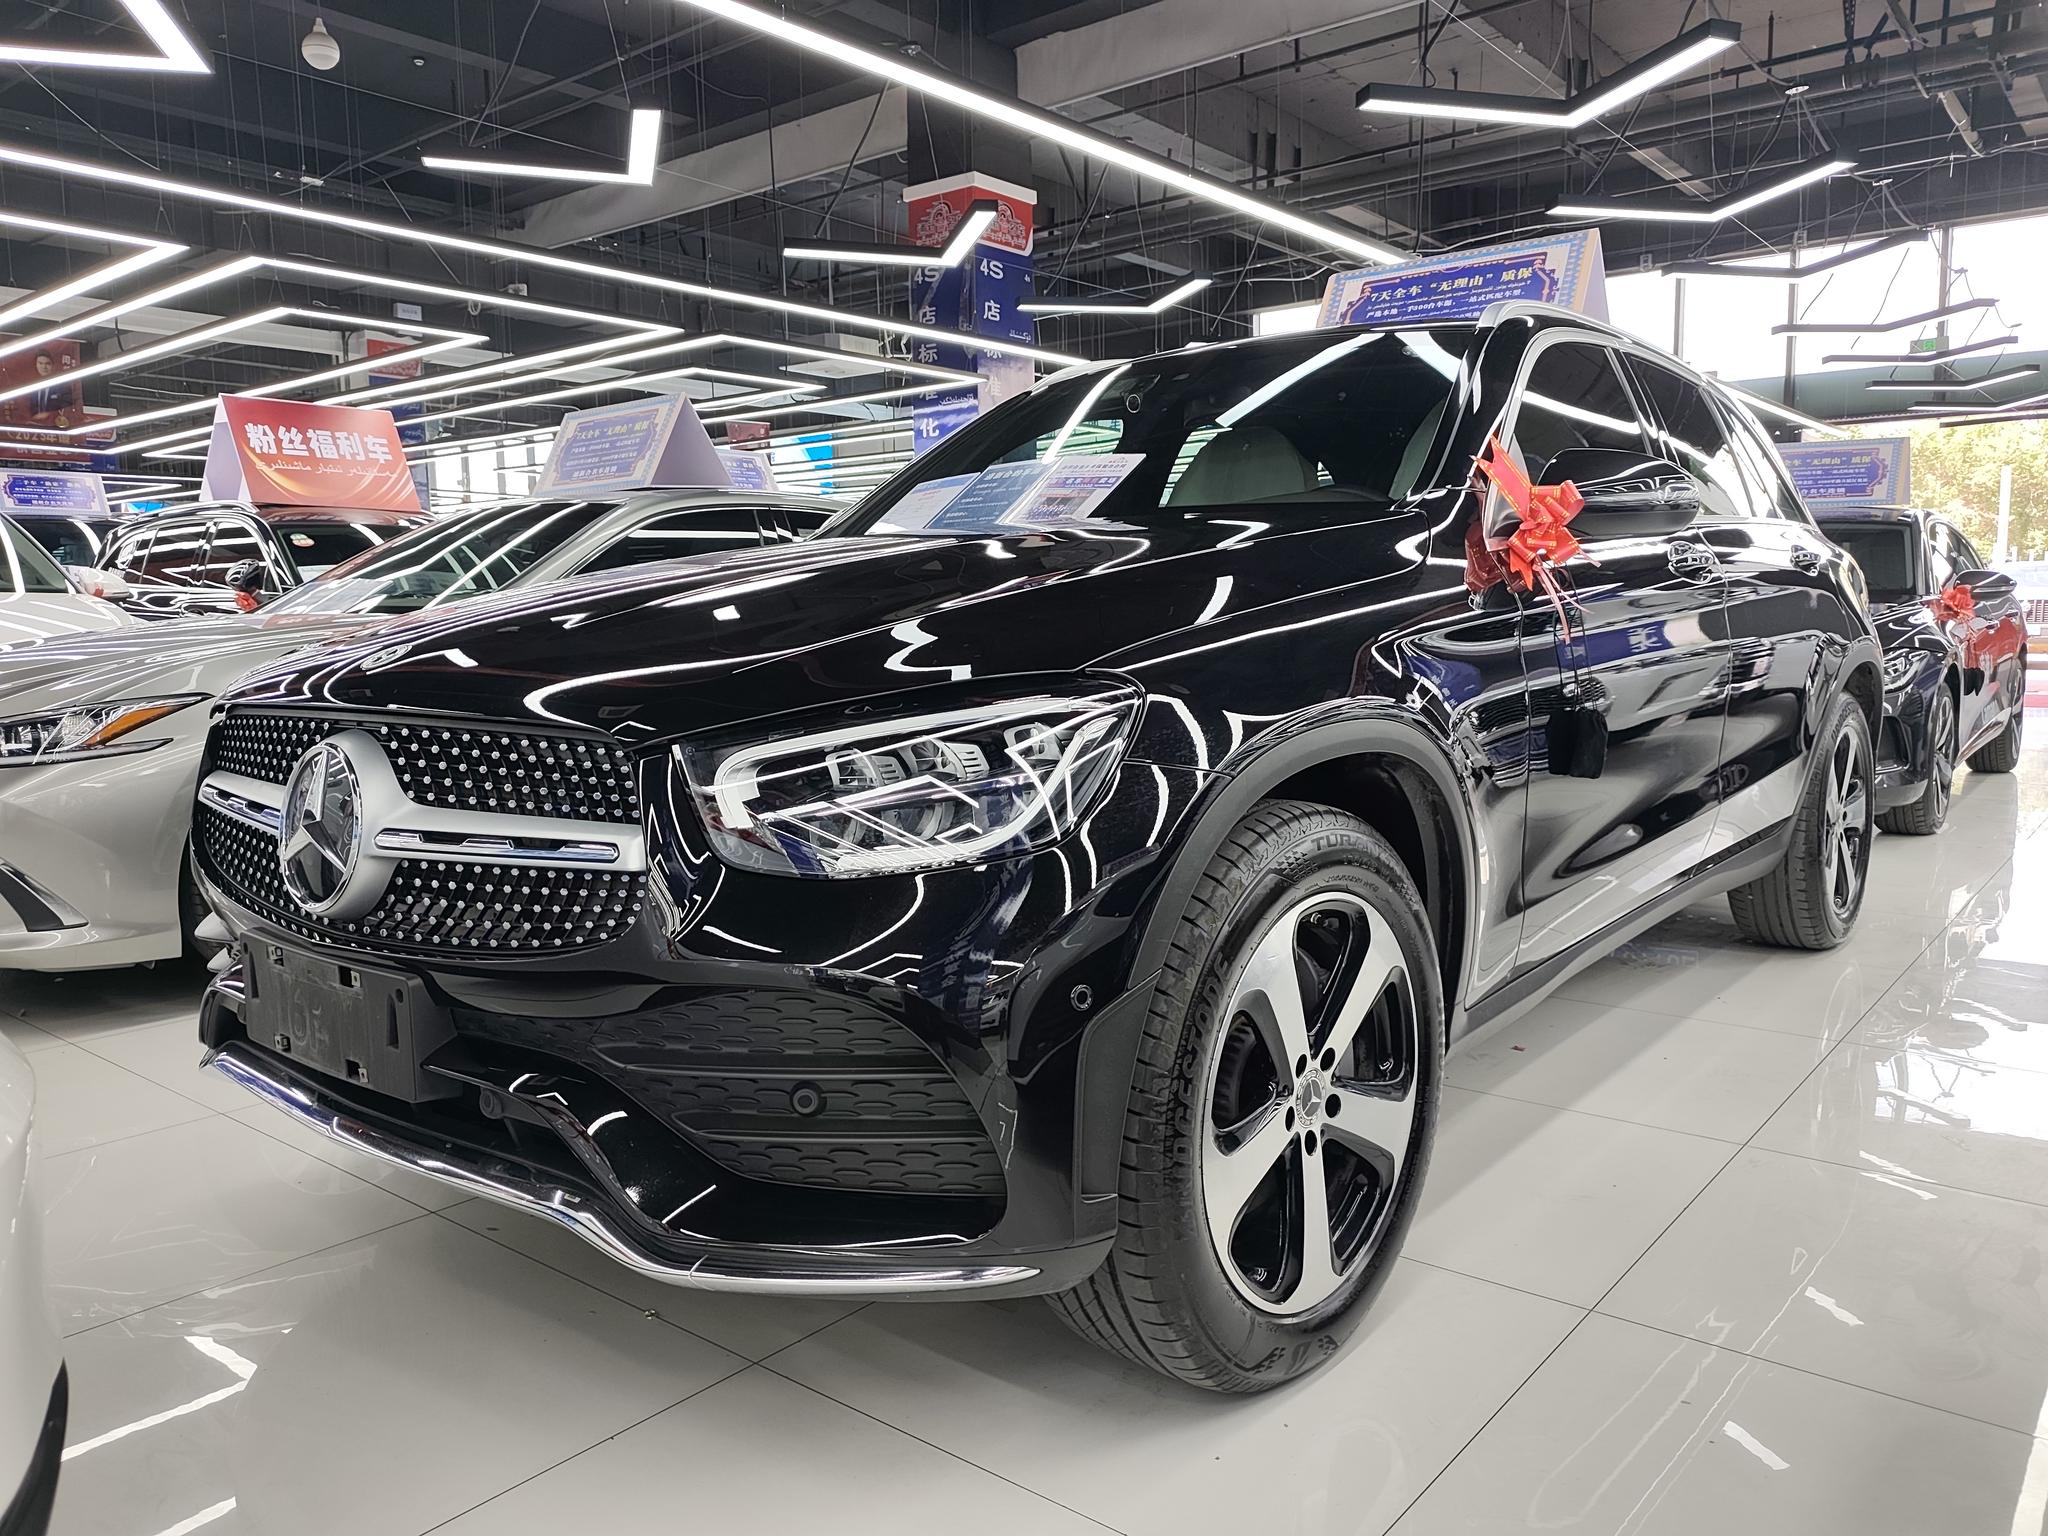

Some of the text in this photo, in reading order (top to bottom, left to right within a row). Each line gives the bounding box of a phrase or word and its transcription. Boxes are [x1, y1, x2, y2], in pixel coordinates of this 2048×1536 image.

[244, 422, 393, 464] 粉丝福利车
